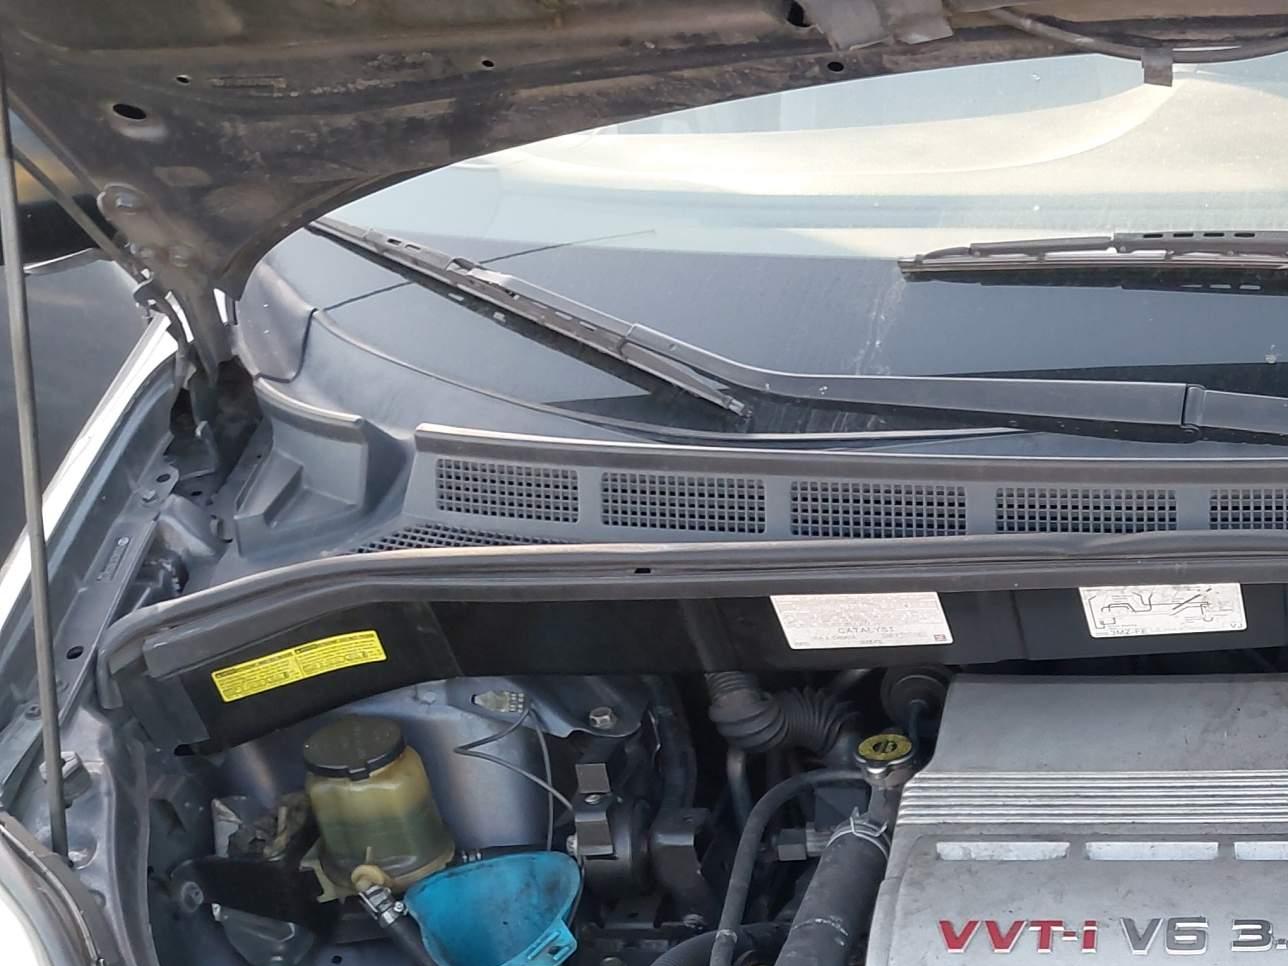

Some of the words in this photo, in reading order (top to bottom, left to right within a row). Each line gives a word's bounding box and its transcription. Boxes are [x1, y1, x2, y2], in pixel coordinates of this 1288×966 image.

[838, 626, 897, 634] CATALYST
[937, 919, 1098, 954] VVT-i
[1120, 916, 1209, 955] V6
